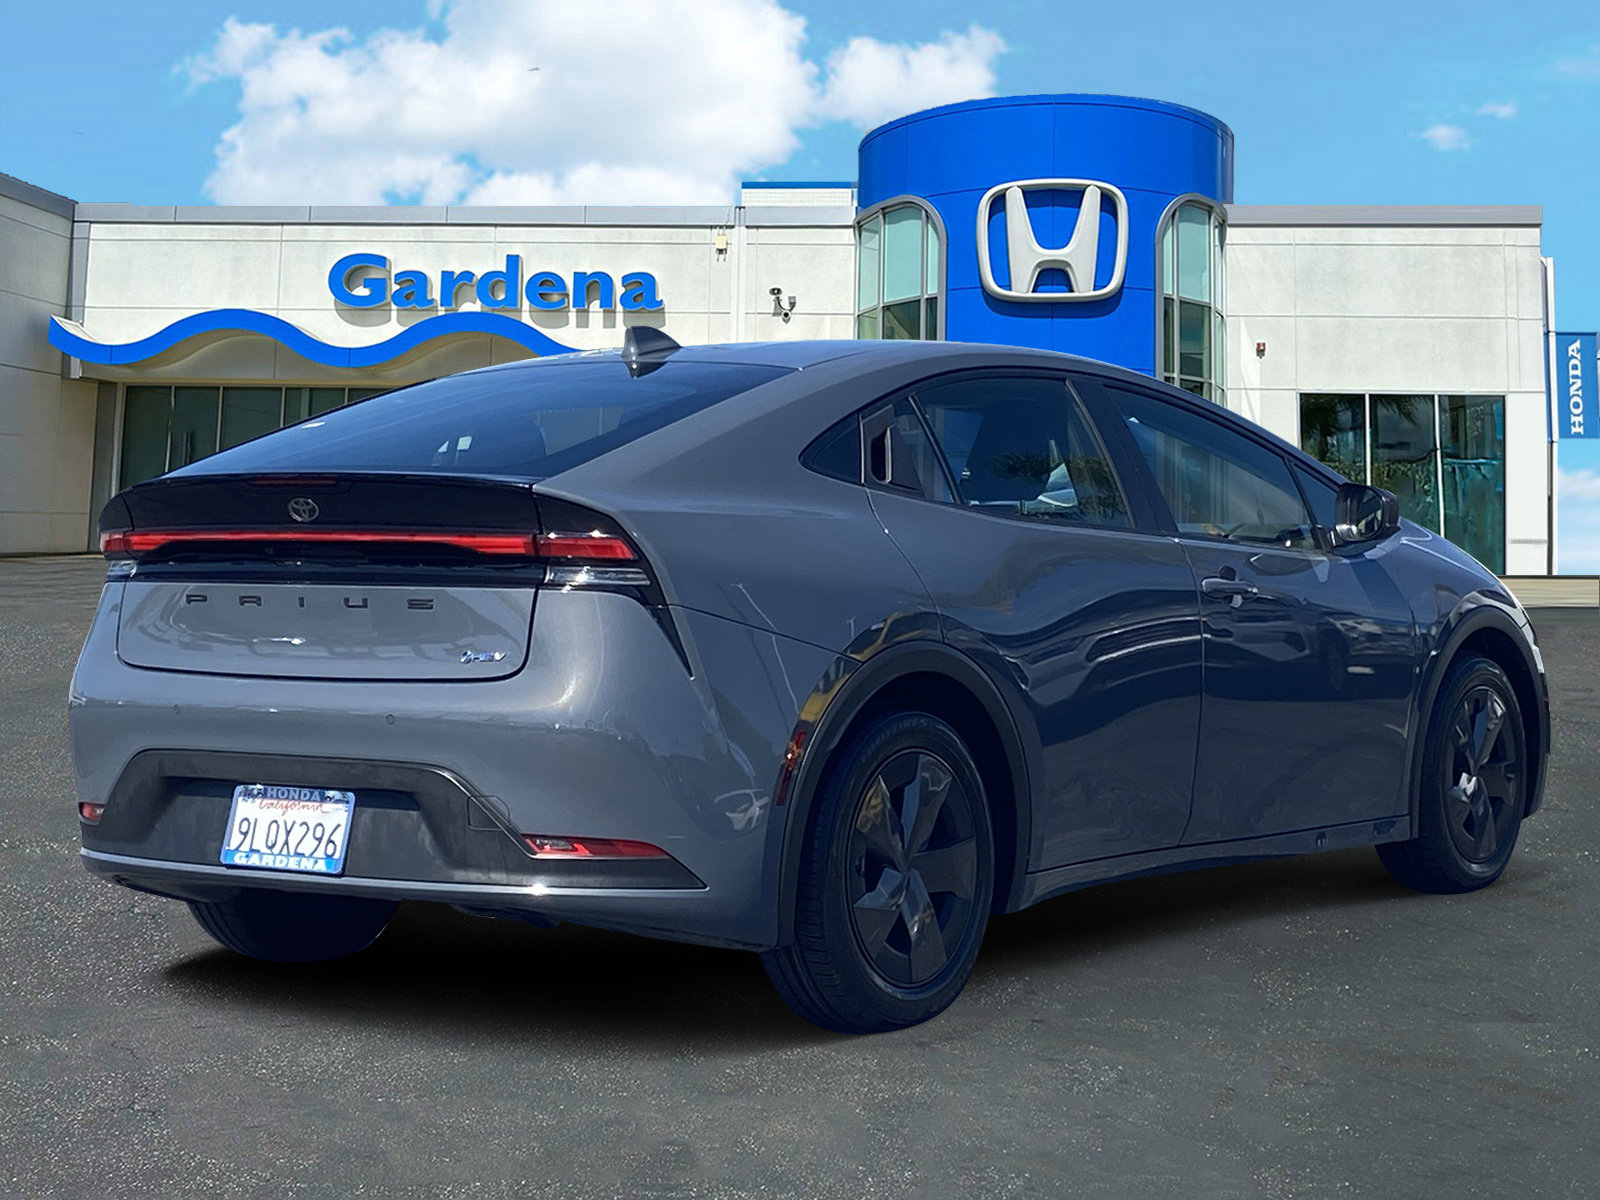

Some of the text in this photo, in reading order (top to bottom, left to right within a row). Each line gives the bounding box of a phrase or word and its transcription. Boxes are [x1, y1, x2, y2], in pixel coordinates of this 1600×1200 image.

[328, 252, 664, 310] Gardena
[1567, 338, 1584, 436] HONDA
[185, 594, 434, 610] PRIUS
[266, 786, 321, 802] HONDA
[233, 851, 327, 872] GARDENA
